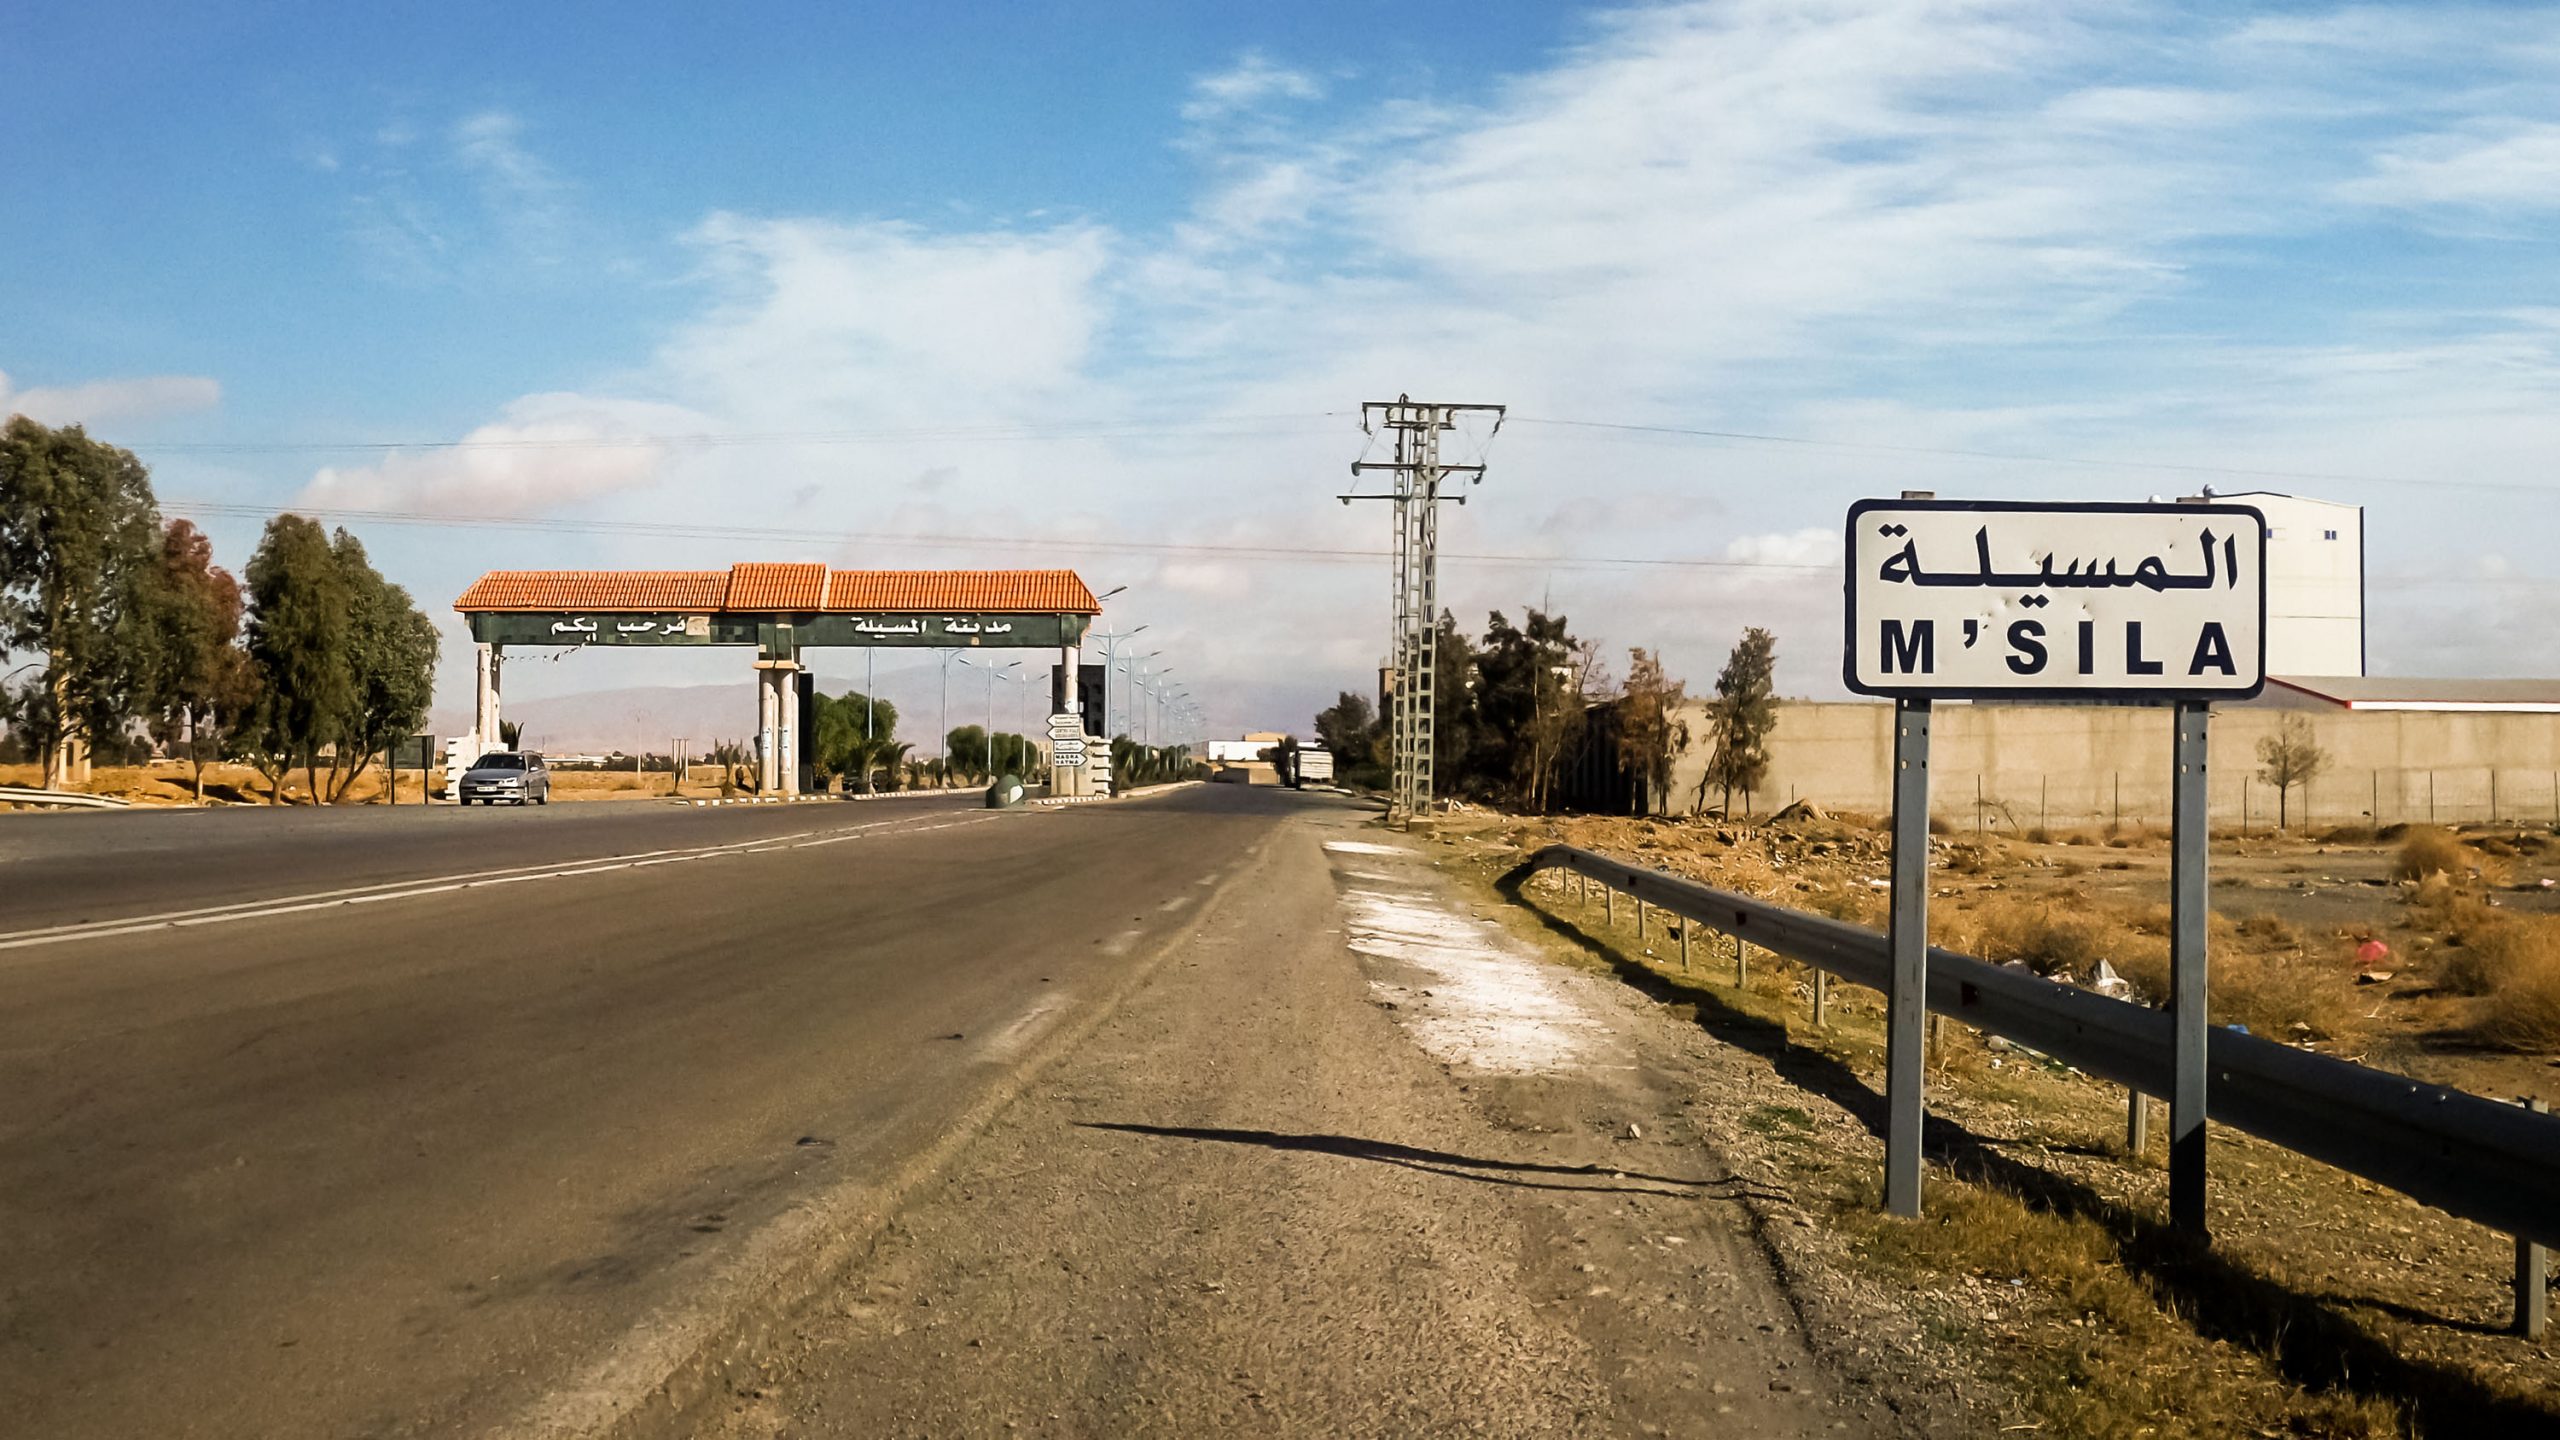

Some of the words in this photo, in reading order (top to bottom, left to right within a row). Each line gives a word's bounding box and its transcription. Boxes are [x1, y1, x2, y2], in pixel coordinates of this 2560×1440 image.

[1878, 523, 2238, 609] المسيلة
[551, 617, 598, 641] بكم
[851, 617, 927, 639] المسيلة
[1880, 619, 2237, 676] M'SILA
